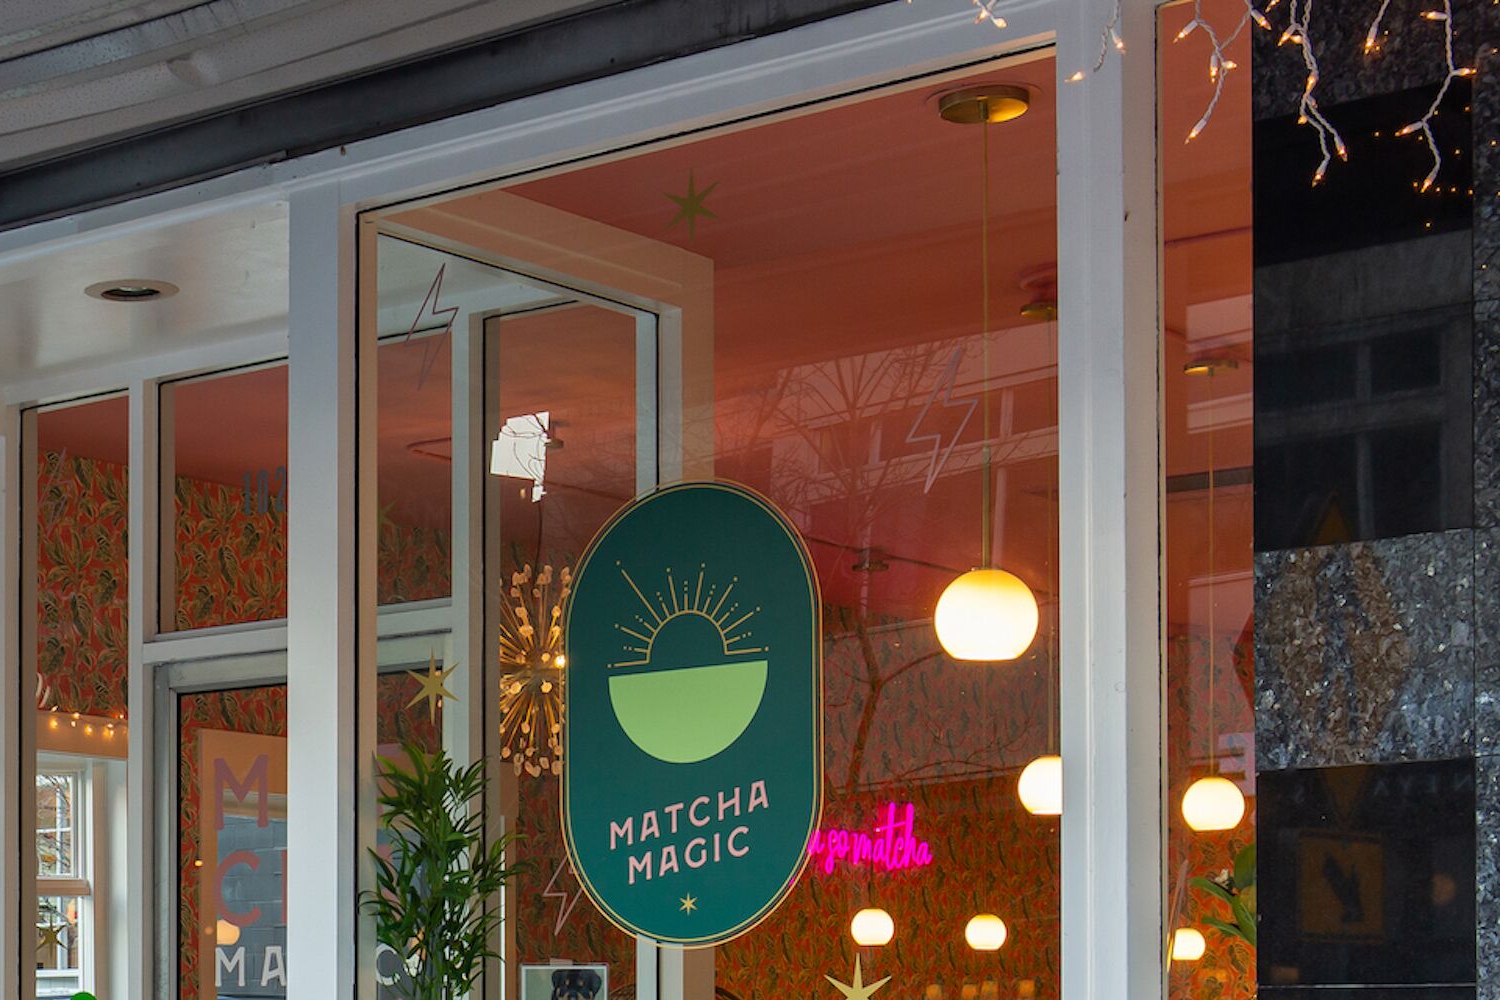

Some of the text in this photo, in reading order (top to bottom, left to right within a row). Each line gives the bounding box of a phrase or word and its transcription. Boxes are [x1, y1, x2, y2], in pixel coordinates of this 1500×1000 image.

[609, 779, 770, 850] MATCHA
[851, 800, 933, 871] matcha
[628, 825, 750, 885] MAGIC
